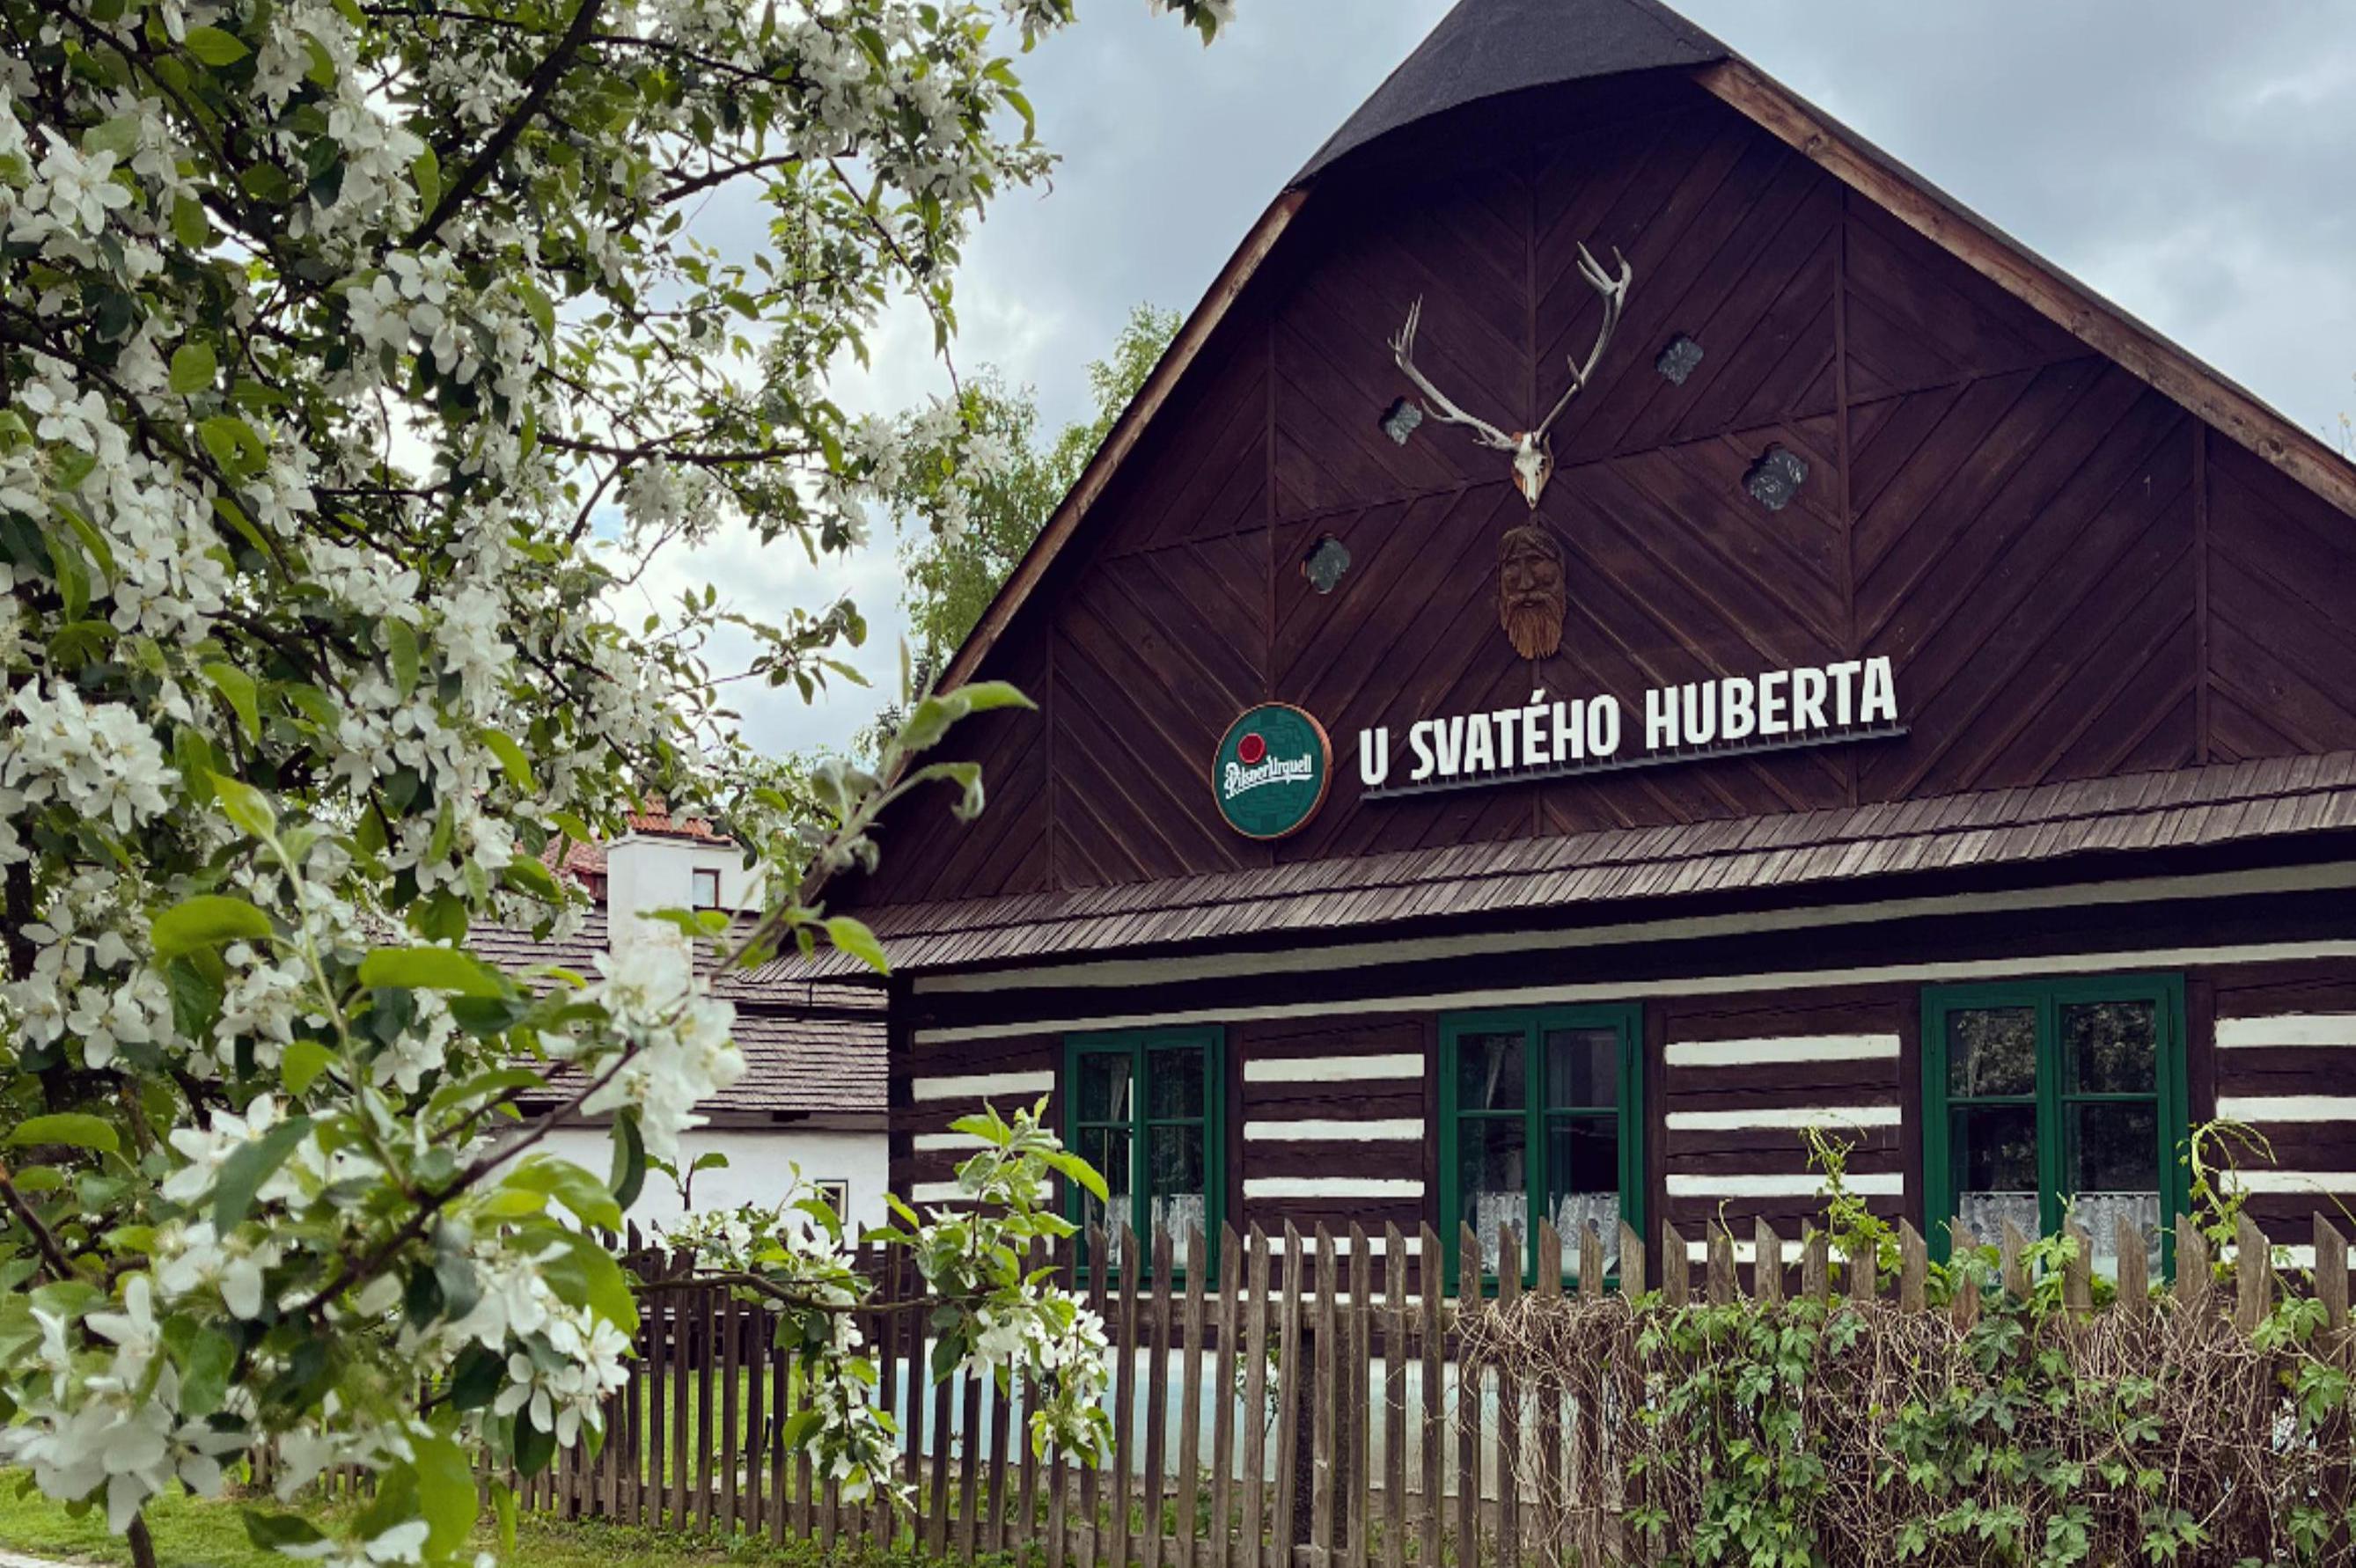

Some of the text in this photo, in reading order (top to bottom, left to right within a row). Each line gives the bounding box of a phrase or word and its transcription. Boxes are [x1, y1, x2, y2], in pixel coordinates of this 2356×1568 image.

[1359, 656, 1897, 785] U SVATÉHO HUBERTA
[1223, 754, 1312, 799] Pilsner Urquell
